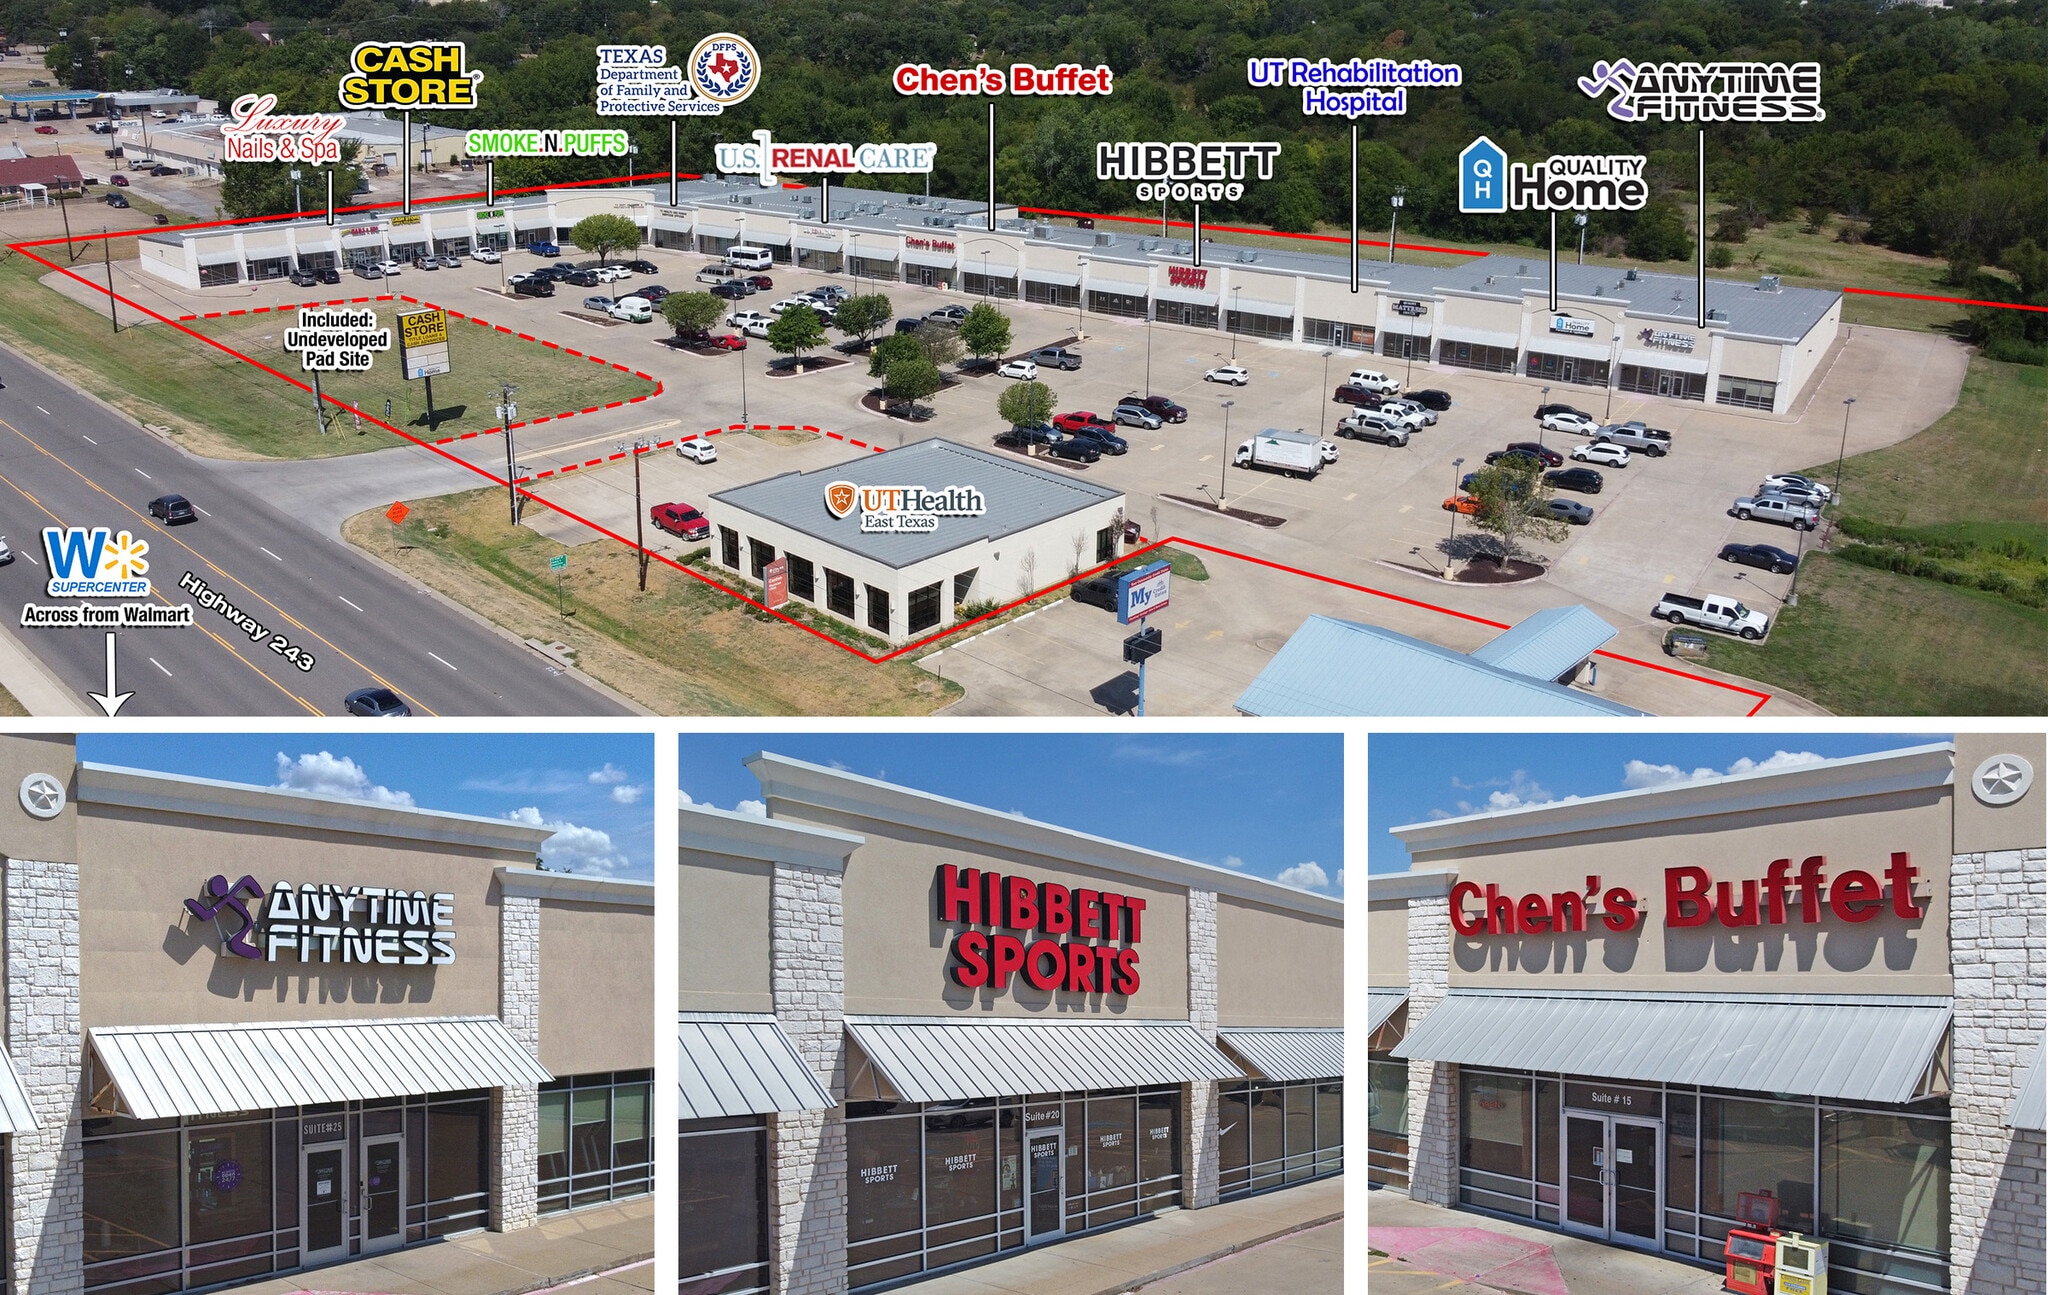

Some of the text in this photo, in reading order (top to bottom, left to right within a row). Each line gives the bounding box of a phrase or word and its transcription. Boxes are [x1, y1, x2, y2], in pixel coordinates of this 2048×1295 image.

[932, 239, 956, 250] Buffet
[1168, 266, 1208, 280] HIBBETT
[1170, 274, 1206, 289] SPORTS
[408, 312, 440, 326] CASH
[404, 322, 444, 338] STORE
[1565, 321, 1590, 331] Home
[1652, 336, 1695, 349] FITNESS
[1131, 587, 1152, 608] My
[1664, 851, 1923, 927] Buffet
[268, 880, 454, 927] ANYTIME
[937, 864, 1146, 944] HIBBETT
[267, 923, 457, 965] FITNESS
[951, 931, 1141, 996] SPORTS
[1591, 1092, 1632, 1106] Suite # 15
[1150, 1126, 1169, 1135] HIBBETT
[1151, 1132, 1168, 1140] SPORTS
[1100, 1133, 1122, 1142] HIBBETT
[1102, 1140, 1120, 1148] SPORTS
[1031, 1142, 1057, 1153] HIBBETT
[1033, 1150, 1055, 1158] SPORTS
[945, 1153, 977, 1165] HIBBETT
[860, 1164, 898, 1177] HIBBETT
[948, 1161, 974, 1172] SPORTS
[865, 1173, 894, 1184] SPORTS
